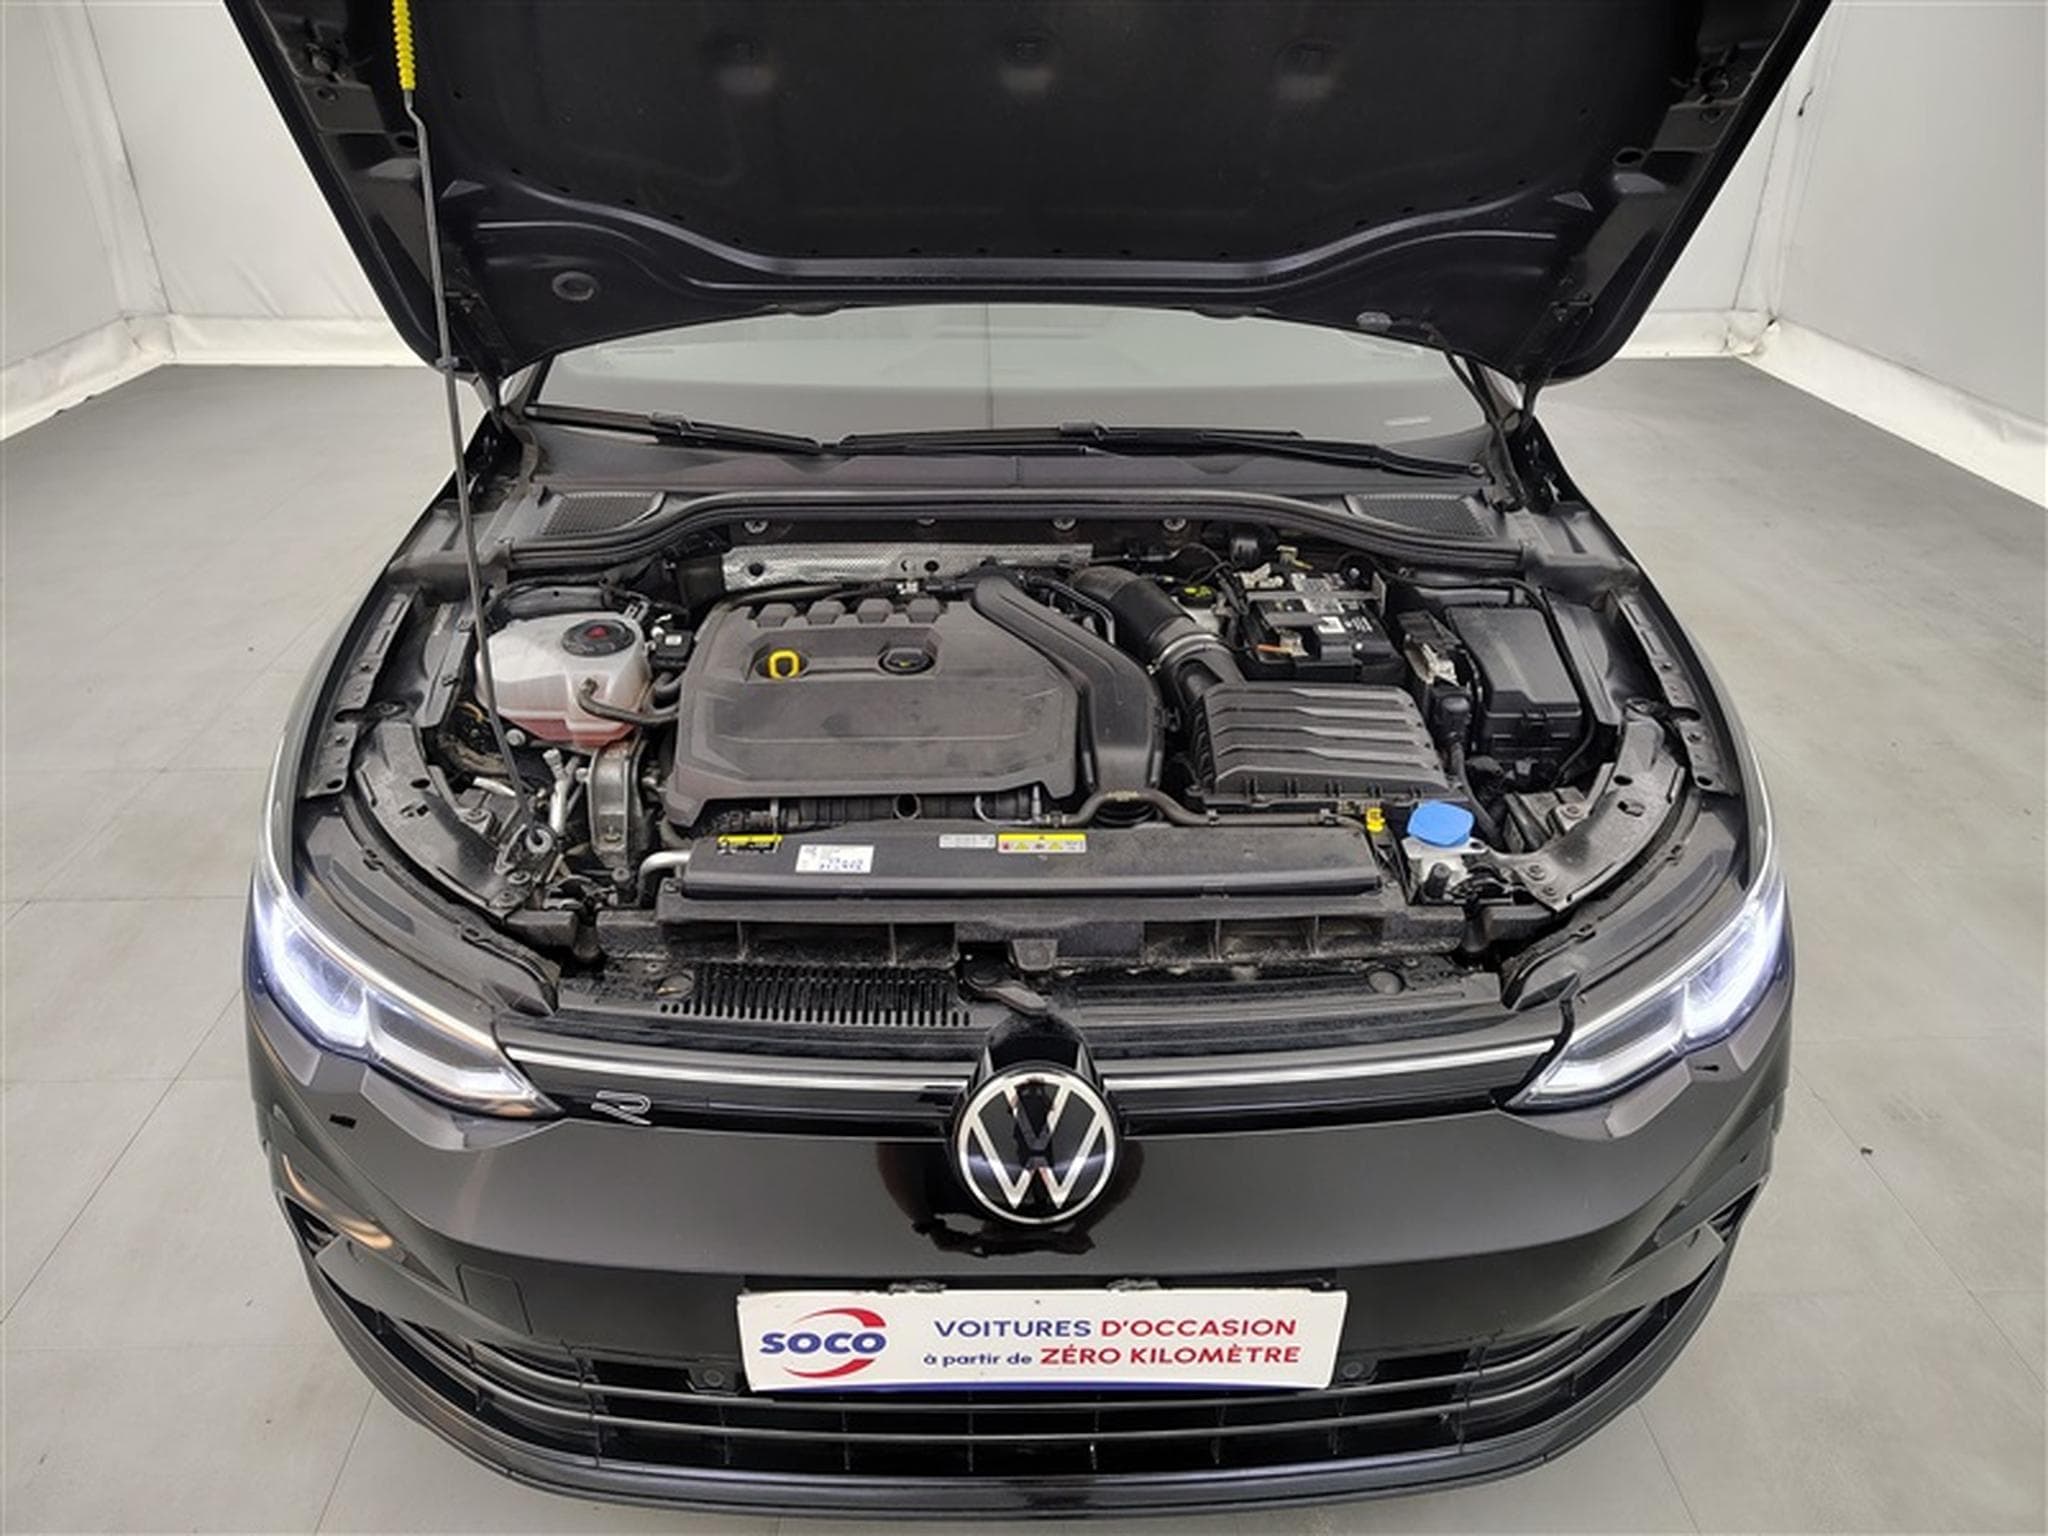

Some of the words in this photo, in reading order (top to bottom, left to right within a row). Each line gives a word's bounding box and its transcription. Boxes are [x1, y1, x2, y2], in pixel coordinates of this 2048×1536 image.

[934, 1320, 1091, 1338] VOITURES
[1101, 1319, 1297, 1338] D'OCCASION
[760, 1332, 886, 1354] SOCO
[923, 1353, 936, 1365] à
[942, 1354, 1000, 1368] partir
[1007, 1353, 1032, 1365] de
[1040, 1344, 1121, 1365] ZÉRO
[1130, 1343, 1301, 1365] KILOMÈTRE
